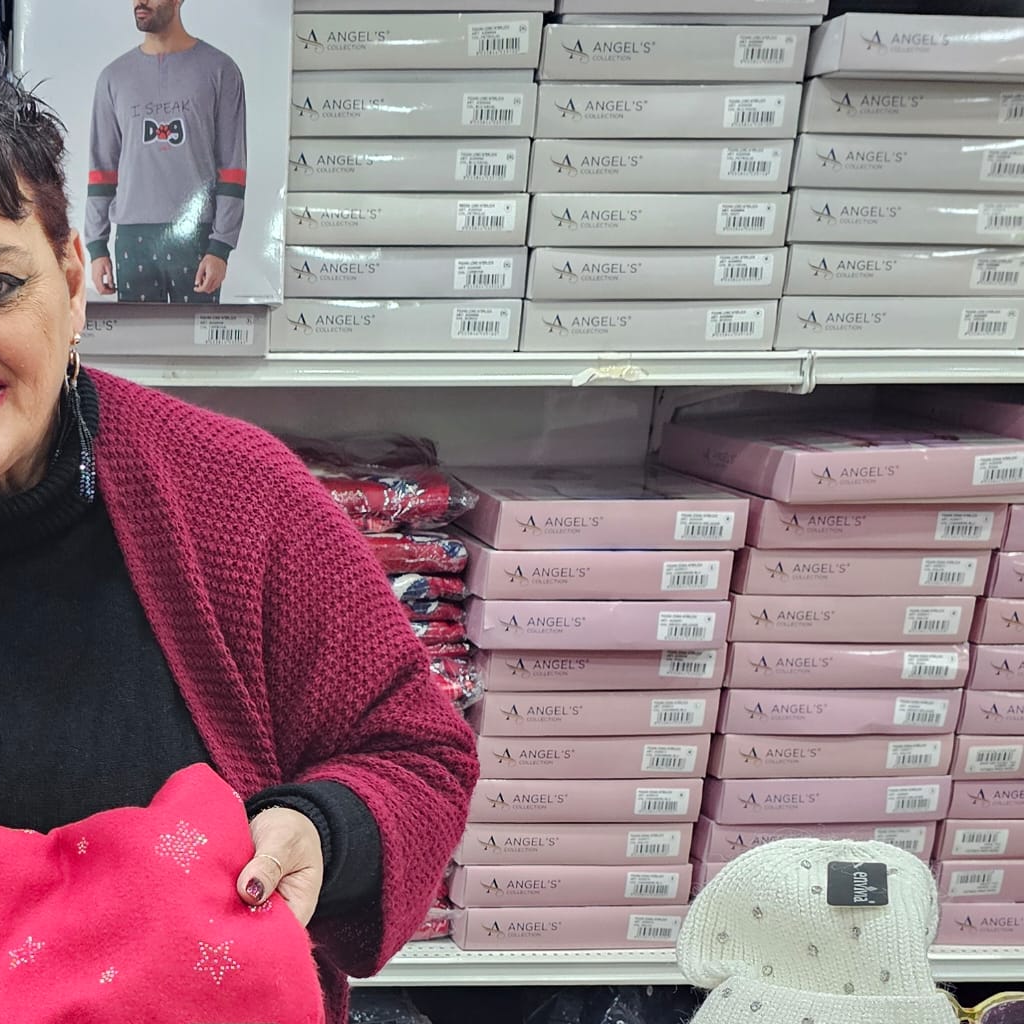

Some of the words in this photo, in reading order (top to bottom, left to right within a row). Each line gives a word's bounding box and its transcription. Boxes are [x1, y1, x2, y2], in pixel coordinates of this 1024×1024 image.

[327, 31, 385, 41] ANGEL'S
[592, 42, 651, 53] ANGEL'S
[322, 100, 379, 110] ANGEL'S
[585, 101, 643, 111] ANGEL'S
[861, 96, 919, 107] ANGEL'S
[145, 100, 190, 115] SPEAK
[316, 155, 373, 165] ANGELS
[581, 156, 638, 166] ANGEL'S
[845, 152, 902, 162] ANGEL'S
[321, 209, 376, 219] ANGEL'S
[581, 210, 637, 220] ANGEL'S
[841, 207, 897, 216] ANGEL'S
[320, 264, 375, 273] ANGEL'S
[581, 264, 638, 273] ANGEL'S
[837, 260, 892, 270] ANGEL'S
[316, 316, 371, 325] ANGEL'S
[571, 317, 627, 326] ANGEL'S
[826, 313, 882, 323] ANGEL'S
[85, 320, 113, 331] EL'S
[840, 466, 894, 477] ANGEL'S
[545, 517, 599, 526] ANGEL'S
[808, 516, 862, 526] ANGEL'S
[532, 568, 586, 577] ANGEL'S
[792, 564, 846, 573] ANGEL'S
[777, 611, 831, 620] ANGEL'S
[527, 617, 581, 627] ANGEL'S
[533, 660, 585, 669] ANGEL'S
[776, 658, 829, 667] ANGEL'S
[527, 706, 579, 715] ANGEL'S
[772, 704, 823, 713] ANGEL'S
[519, 750, 571, 759] ANGEL'S
[765, 748, 817, 758] ANGEL'S
[513, 795, 564, 803] ANGEL'S
[764, 794, 815, 803] ANGEL'S
[994, 790, 1024, 800] ANGE
[504, 837, 555, 846] ANGEL'S
[507, 880, 557, 889] ANGEL'S
[508, 922, 558, 931] ANGEL'S
